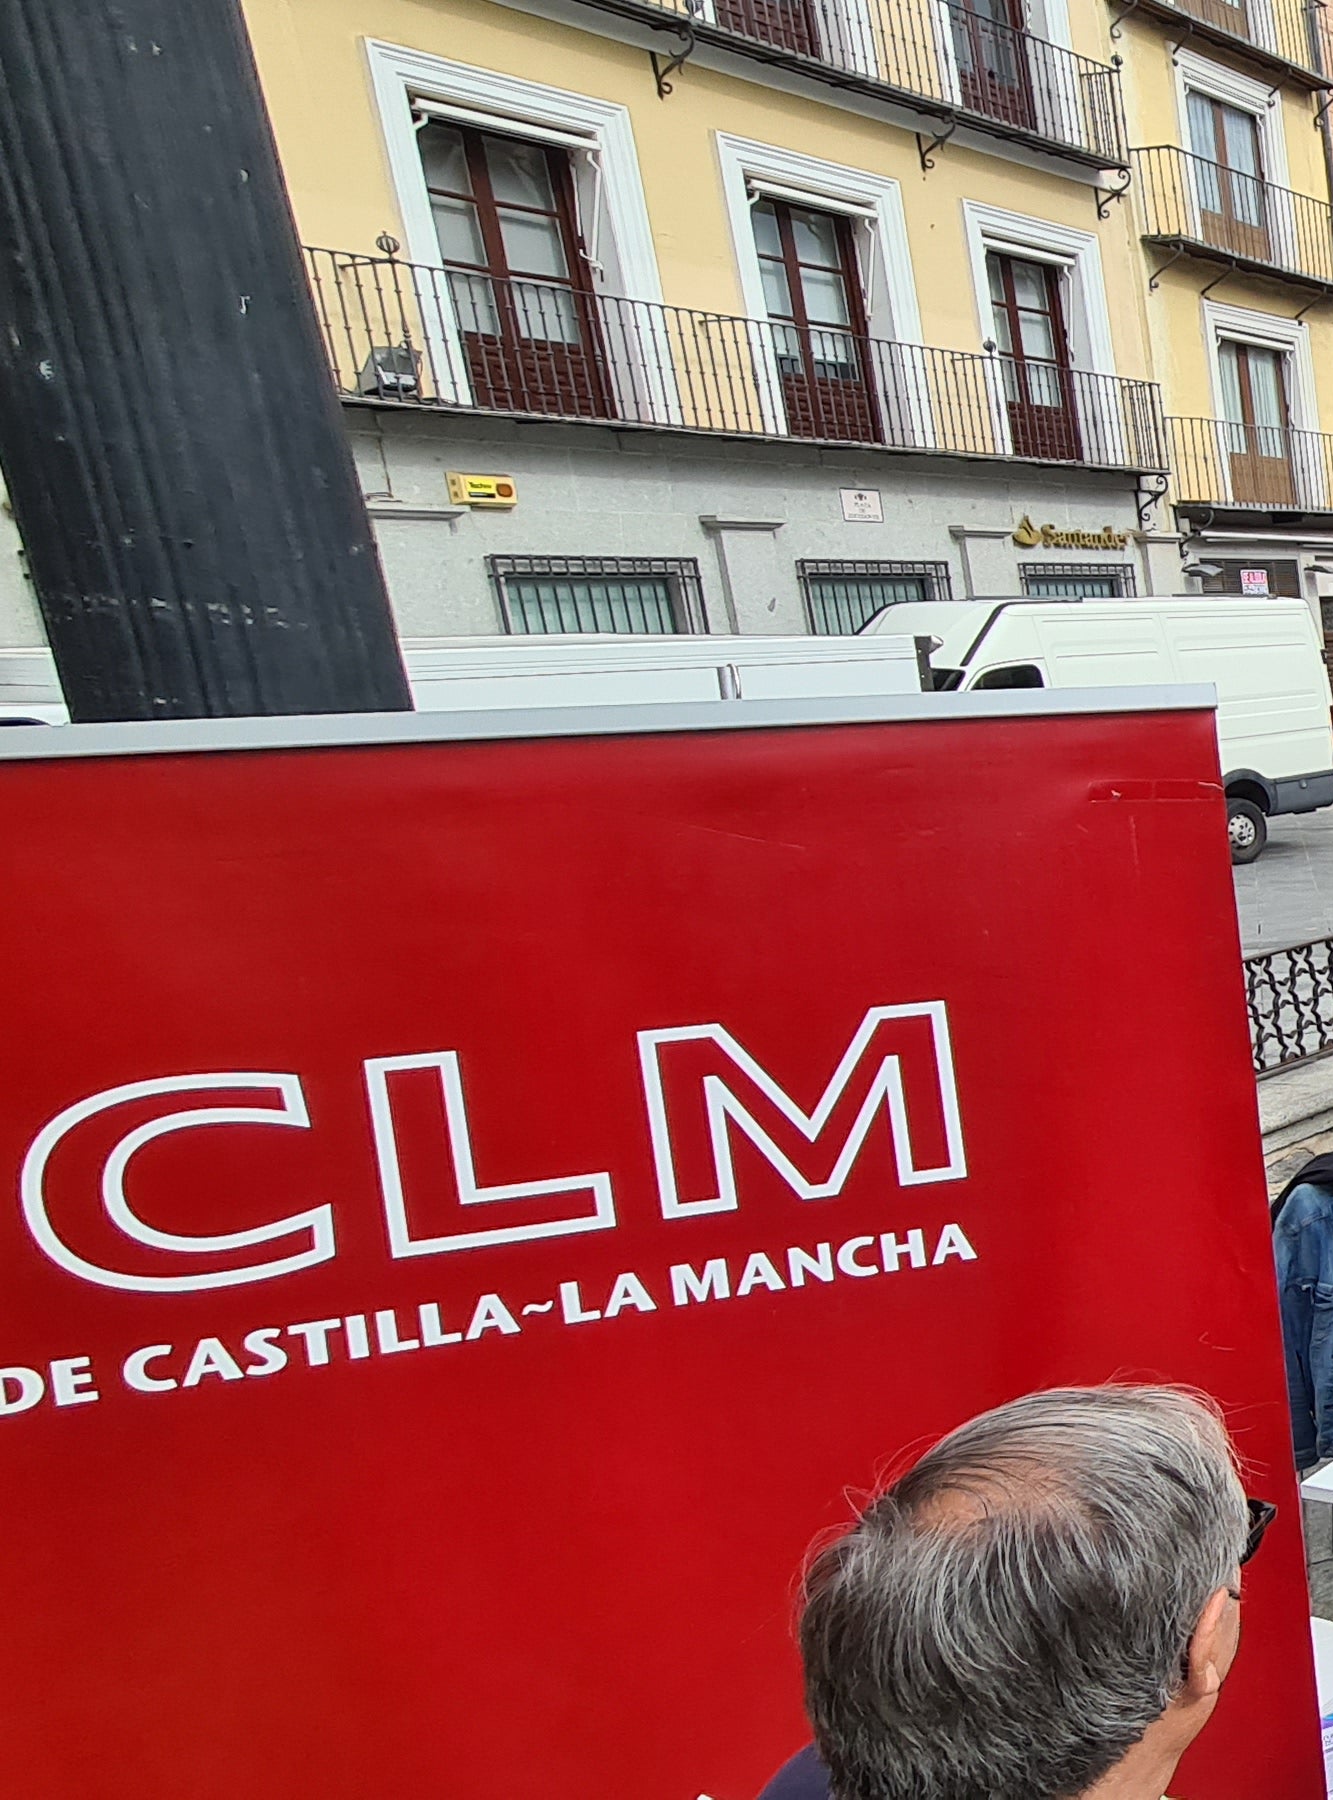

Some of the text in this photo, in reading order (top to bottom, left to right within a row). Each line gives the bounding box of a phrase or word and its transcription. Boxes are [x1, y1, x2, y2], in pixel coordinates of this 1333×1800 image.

[1040, 523, 1128, 551] Santander
[20, 998, 967, 1292] CLM
[0, 1356, 99, 1416] DE
[669, 1223, 978, 1307] MANCHA
